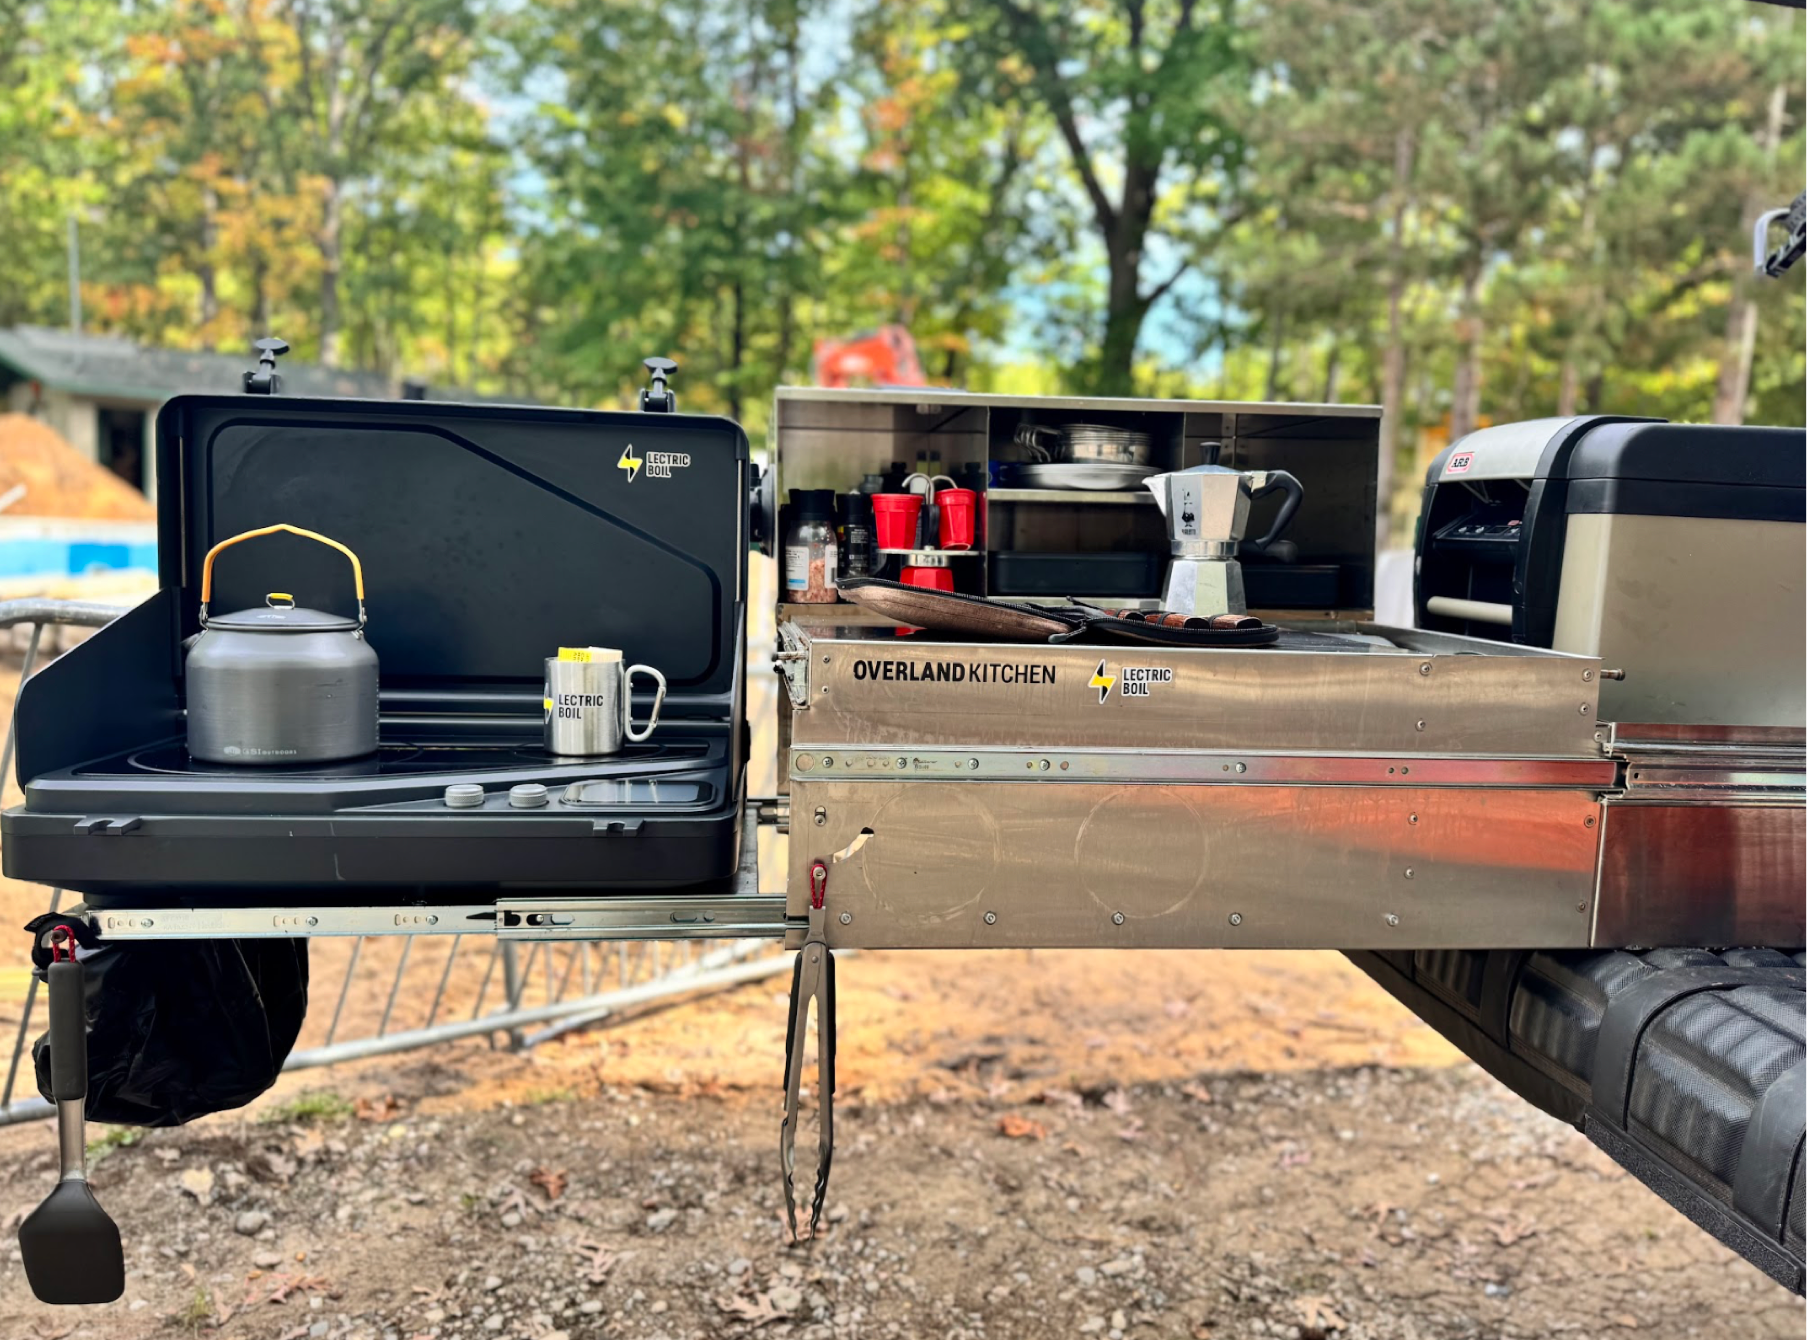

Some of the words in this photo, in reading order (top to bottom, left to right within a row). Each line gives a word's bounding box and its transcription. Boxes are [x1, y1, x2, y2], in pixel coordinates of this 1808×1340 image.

[647, 453, 689, 466] LECTRIC
[1451, 457, 1470, 468] ARB
[647, 465, 670, 477] BOIL
[853, 660, 966, 682] OVERLAND
[968, 662, 1056, 684] KITCHEN
[1123, 668, 1171, 681] LECTRIC
[1123, 682, 1149, 695] BOIL
[558, 694, 604, 707] LECTRIC
[558, 707, 582, 720] BOIL
